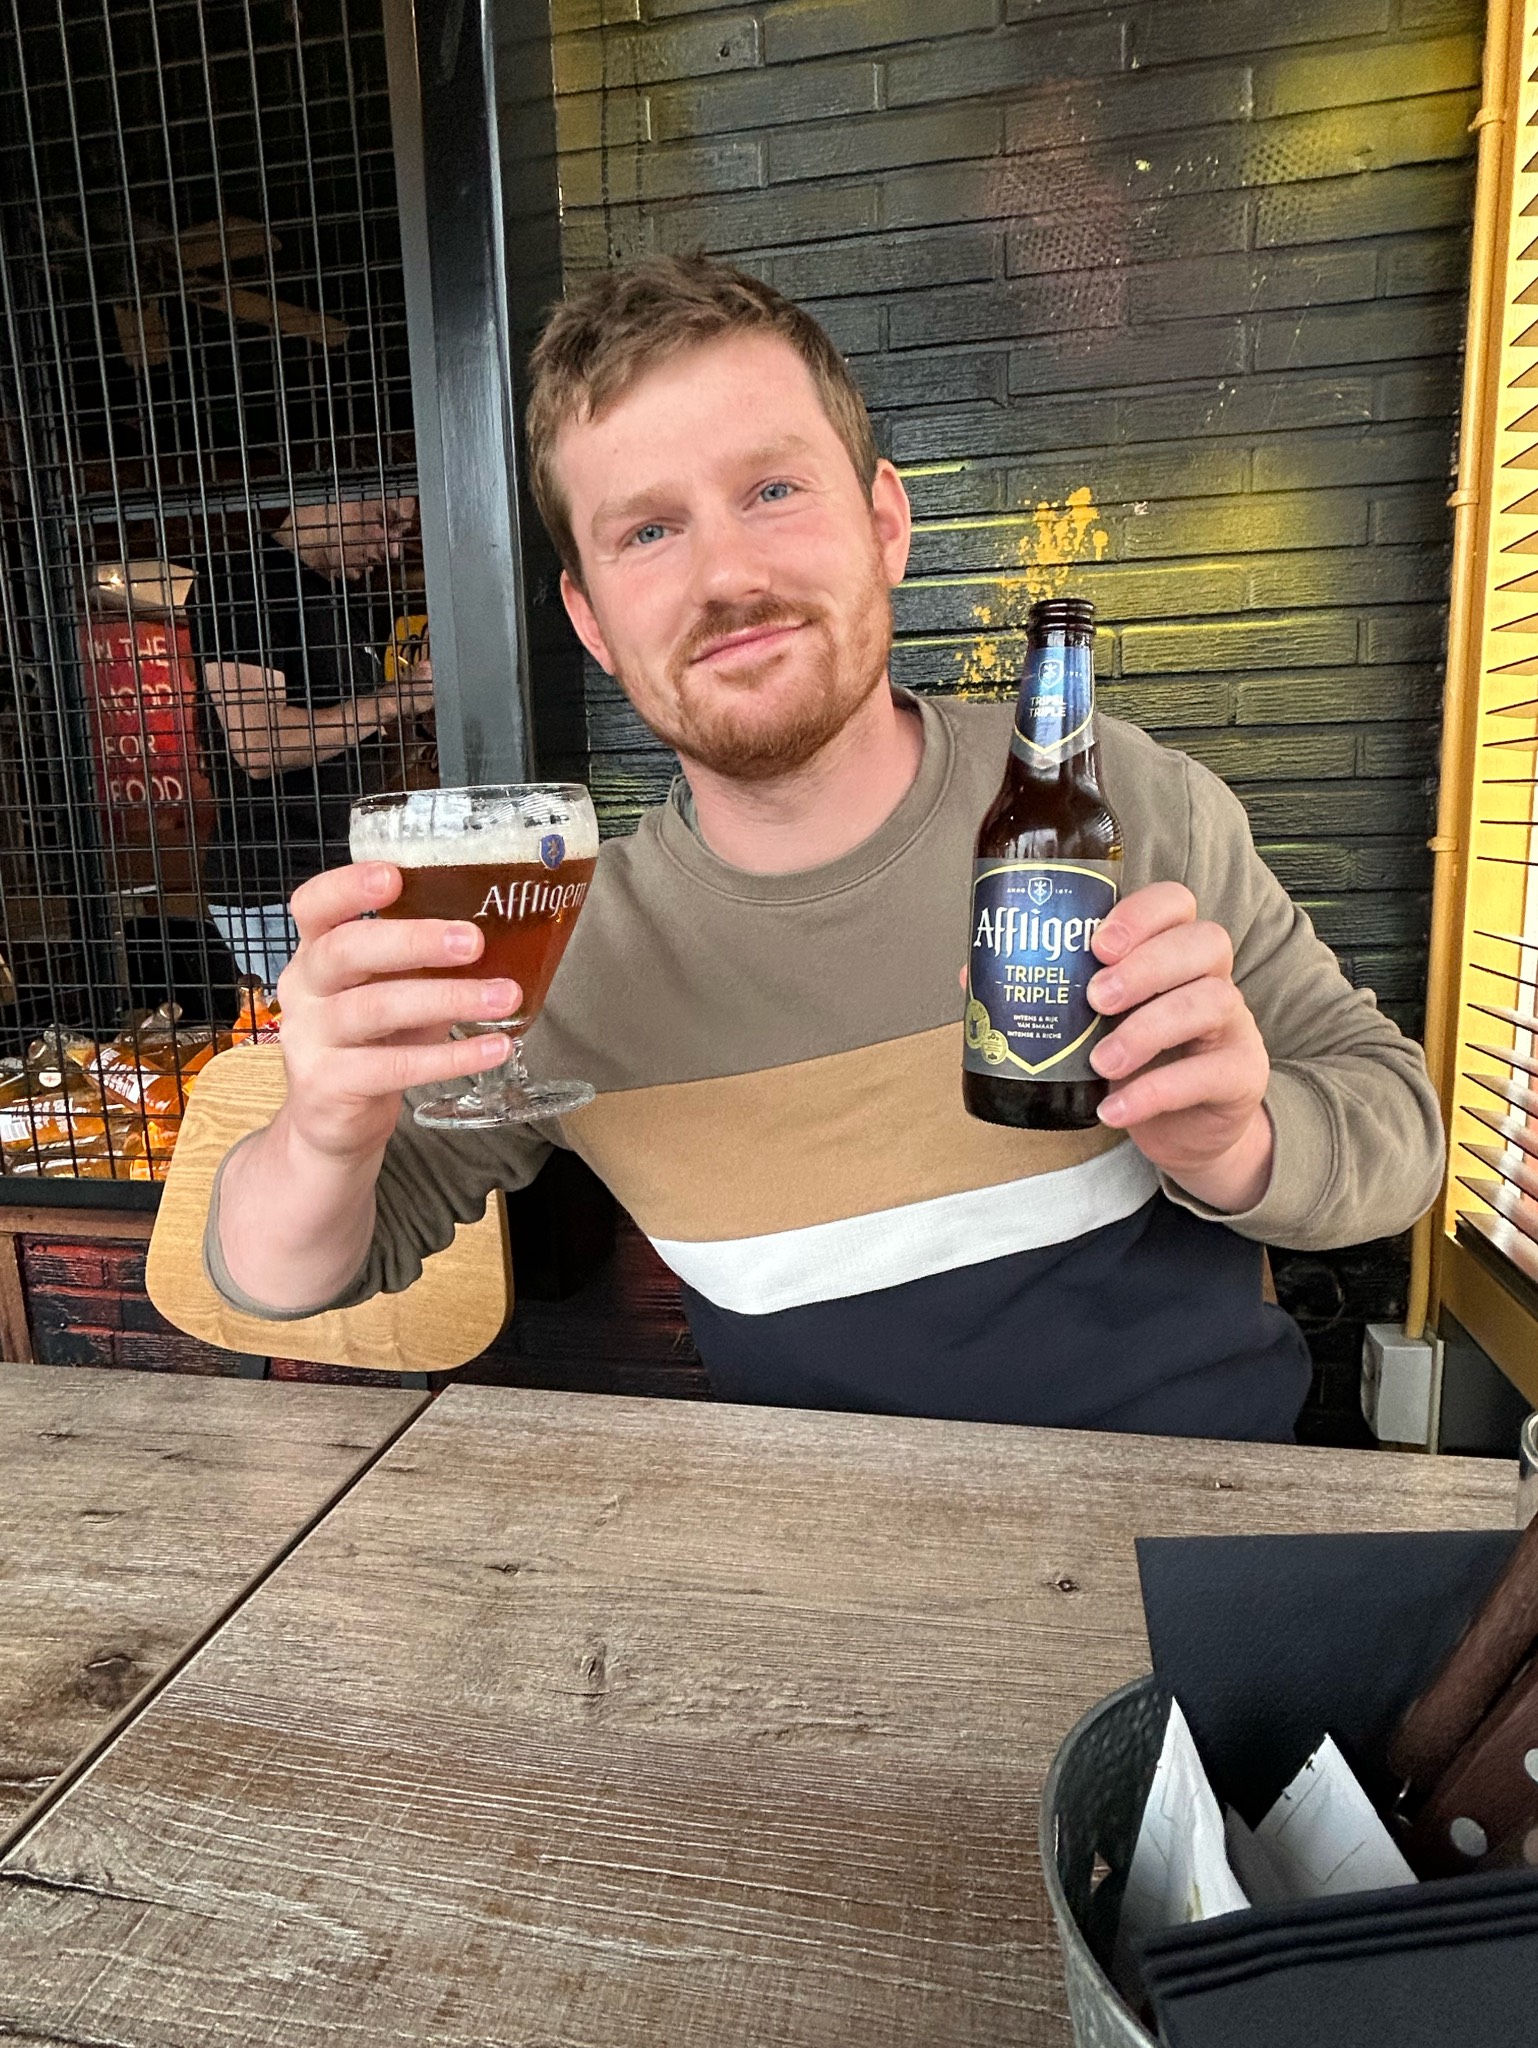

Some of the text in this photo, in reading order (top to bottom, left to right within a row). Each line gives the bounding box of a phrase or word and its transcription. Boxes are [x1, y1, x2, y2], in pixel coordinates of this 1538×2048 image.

[119, 636, 169, 668] THE
[105, 734, 161, 764] FOR
[110, 775, 183, 808] FOOD
[473, 879, 588, 921] Affligem
[1005, 965, 1070, 984] TRIPEL
[1003, 985, 1069, 1004] TRIPLE
[1013, 1014, 1037, 1022] INTENS
[1007, 1030, 1034, 1038] INTENSE
